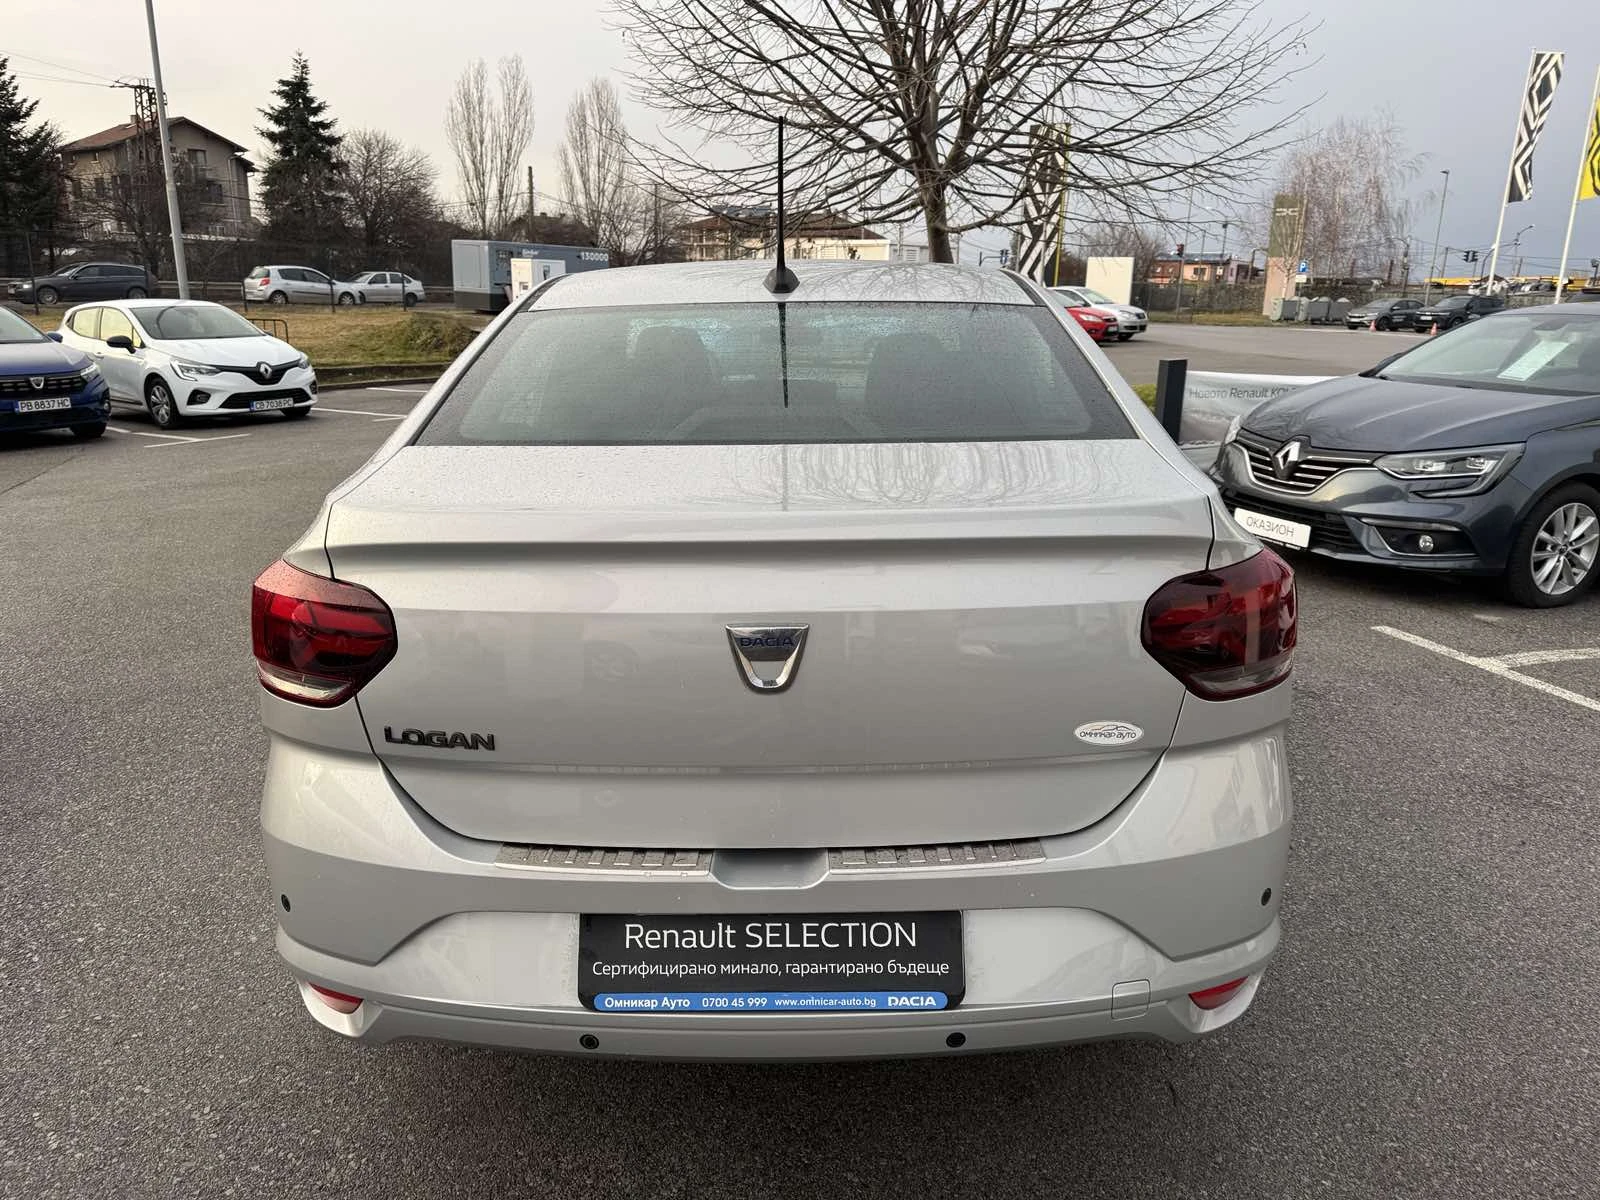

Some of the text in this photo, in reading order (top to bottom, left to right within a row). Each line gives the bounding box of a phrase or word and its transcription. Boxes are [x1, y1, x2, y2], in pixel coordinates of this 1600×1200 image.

[1229, 387, 1269, 399] Renault
[34, 400, 56, 409] 8837
[1246, 516, 1294, 537] ОКАЗИОН
[740, 636, 794, 647] DACIA
[384, 725, 496, 751] LOGAN
[625, 922, 917, 949] Renault SELECTION
[592, 960, 950, 979] Сертифицирано минало, гарантирано бъдеще
[604, 997, 691, 1009] Омникар Ауто
[702, 997, 768, 1007] 0700 45 999
[887, 996, 937, 1007] DACIA
